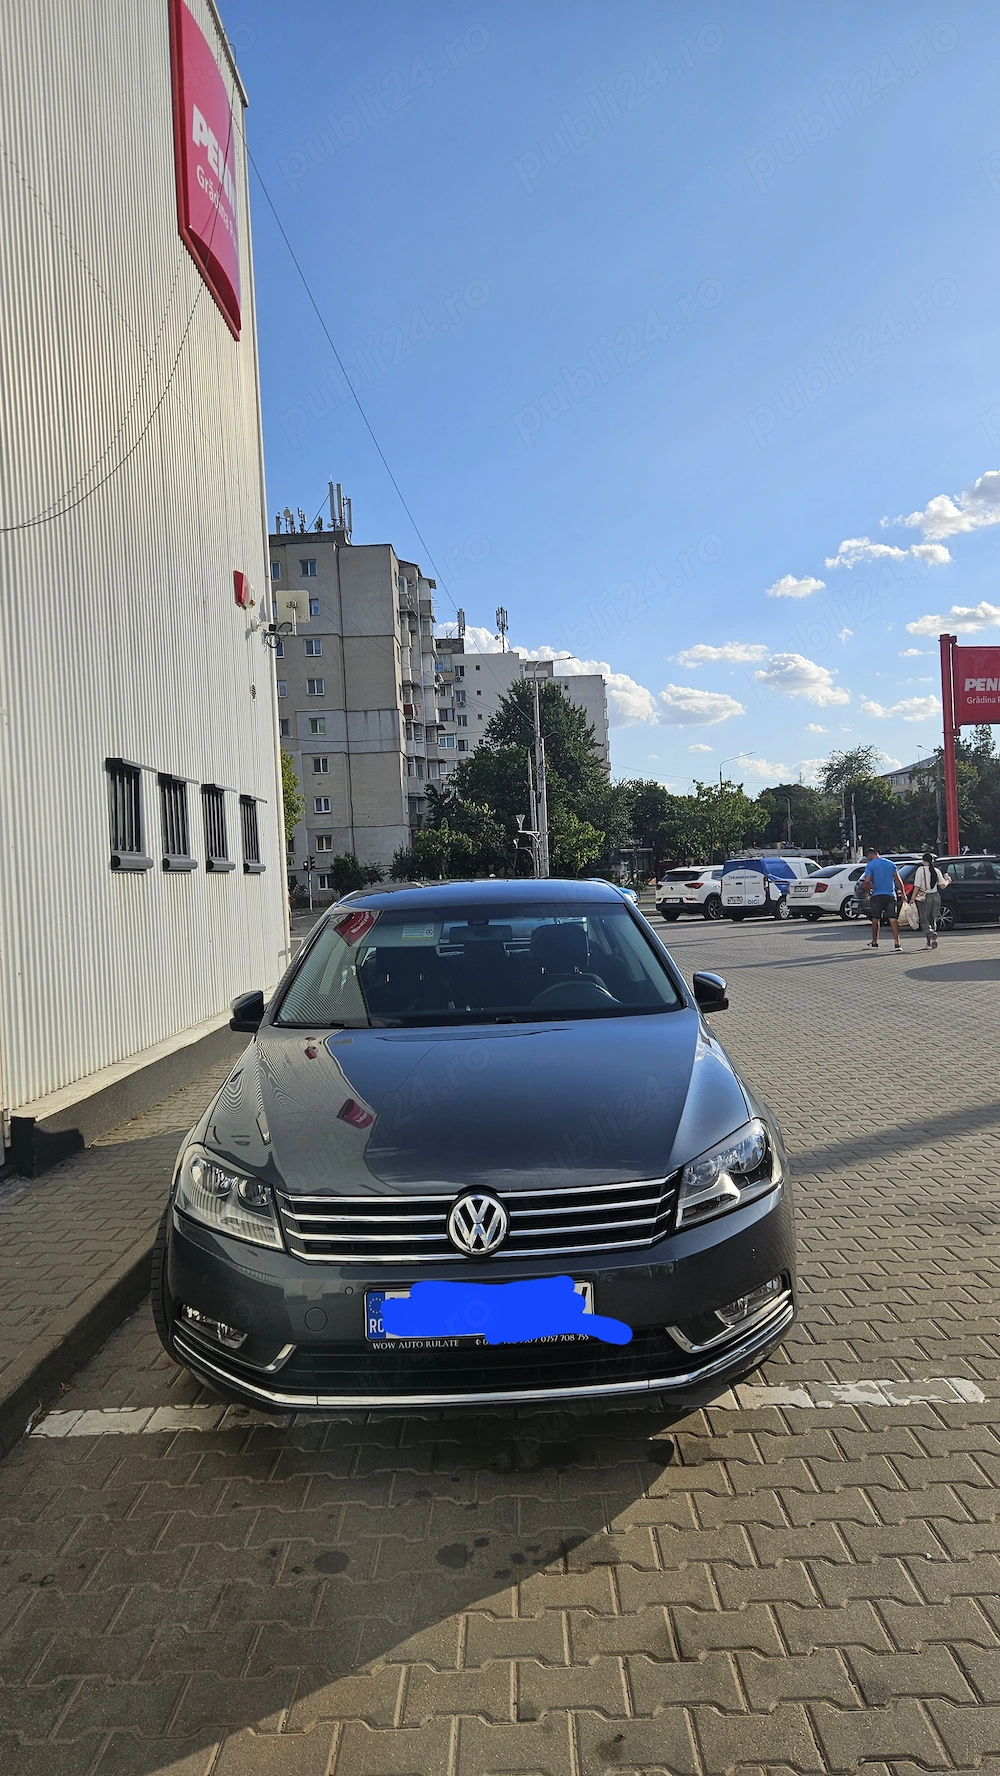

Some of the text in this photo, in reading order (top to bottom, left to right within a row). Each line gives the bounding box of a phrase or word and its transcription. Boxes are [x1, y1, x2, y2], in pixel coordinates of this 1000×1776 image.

[964, 678, 1000, 692] PEN
[966, 696, 996, 704] Grădina
[560, 1334, 576, 1342] 708
[372, 1339, 460, 1350] WOW AUTO RULATE
